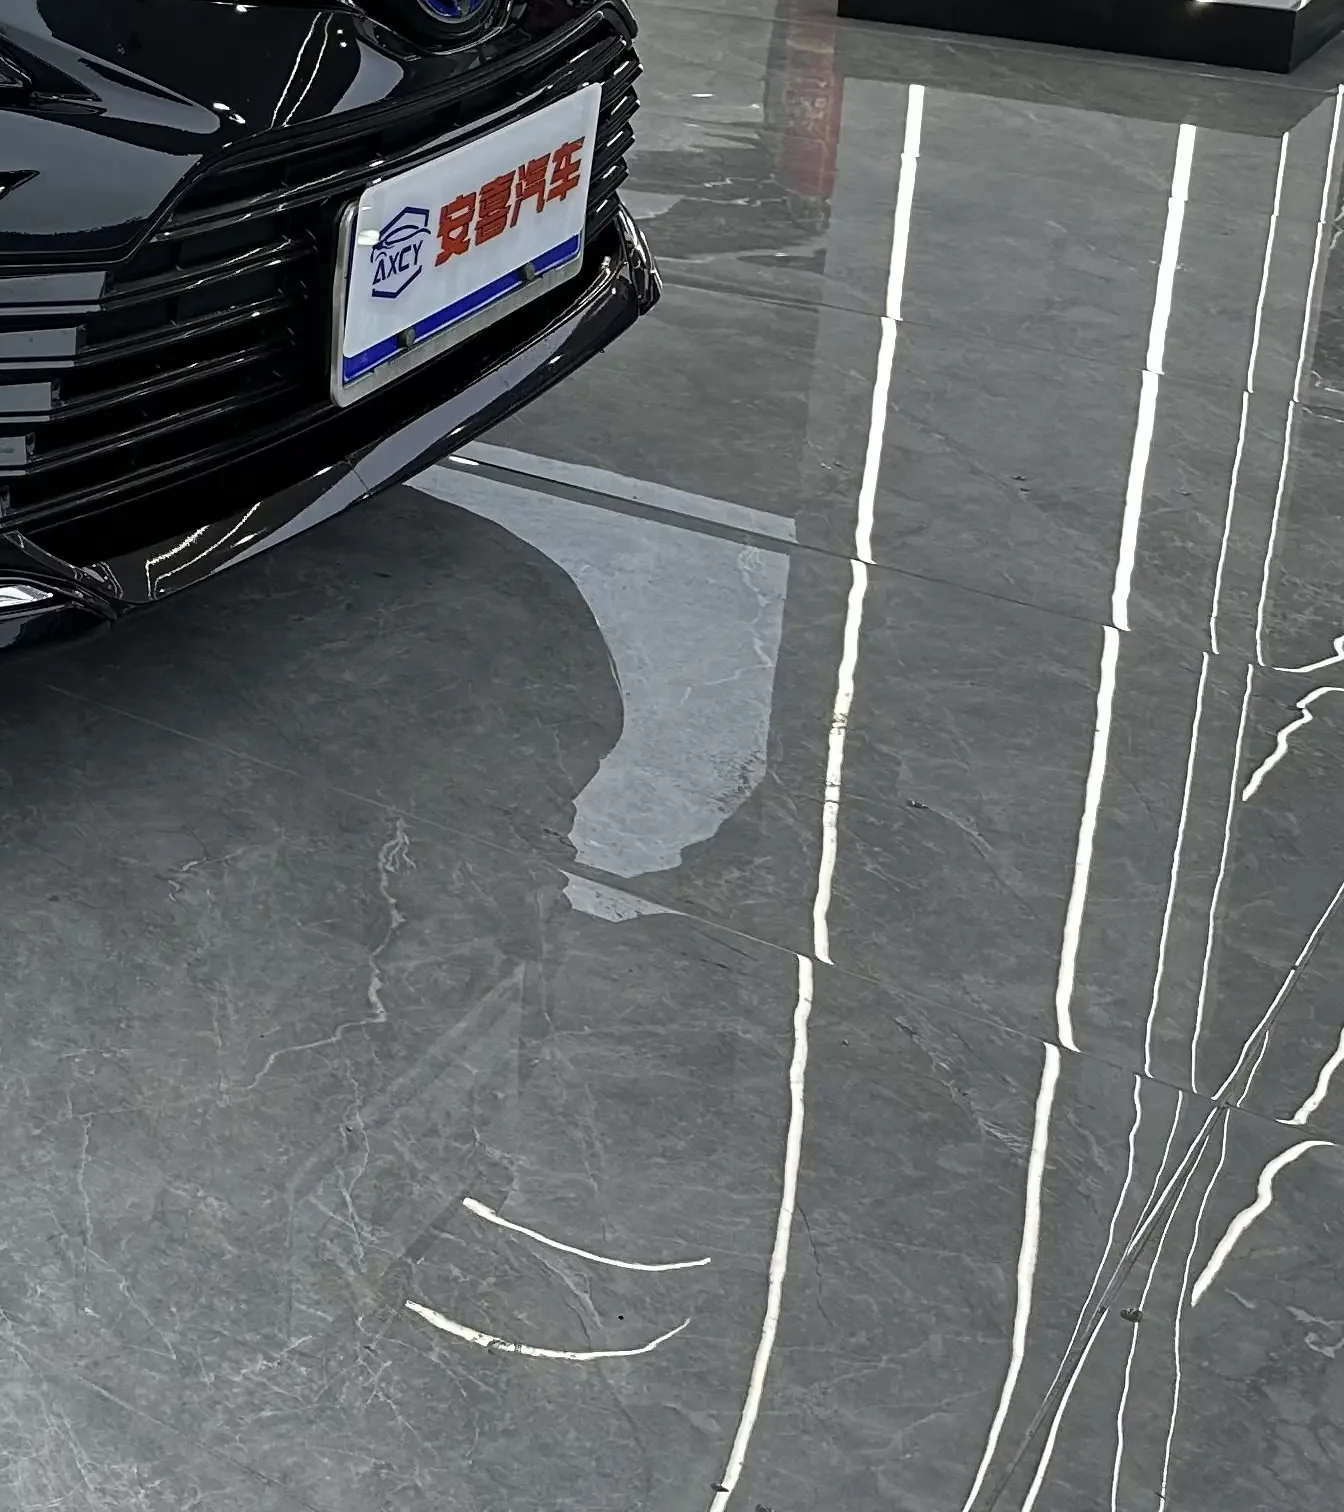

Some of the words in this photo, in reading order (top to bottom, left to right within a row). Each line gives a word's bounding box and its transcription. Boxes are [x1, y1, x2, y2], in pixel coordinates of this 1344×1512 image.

[435, 136, 586, 268] 安喜汽车
[372, 240, 424, 286] AXCY
